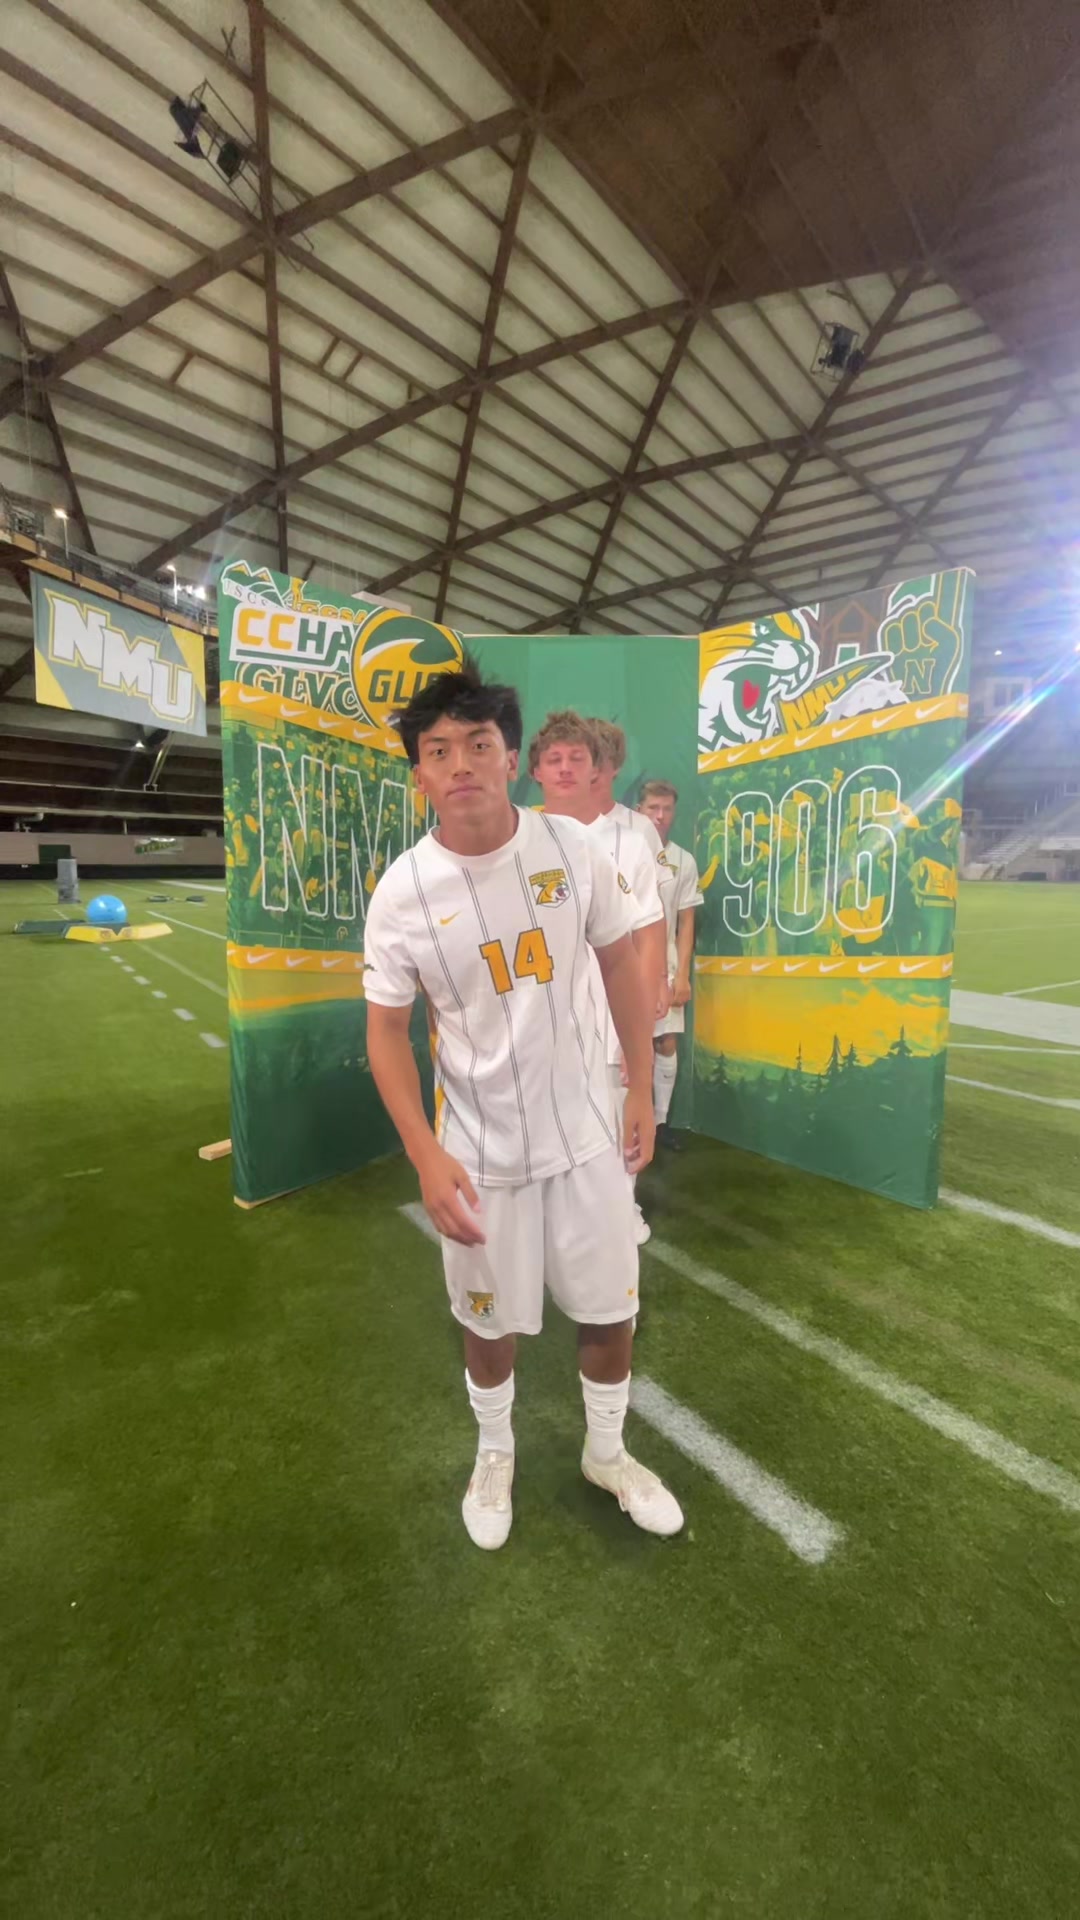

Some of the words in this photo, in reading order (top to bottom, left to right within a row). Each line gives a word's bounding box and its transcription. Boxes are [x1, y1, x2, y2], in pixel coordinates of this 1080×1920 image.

[44, 589, 196, 723] NMU
[237, 608, 353, 664] CCHA
[902, 658, 936, 694] N
[723, 765, 901, 938] 906
[478, 927, 554, 995] 14
